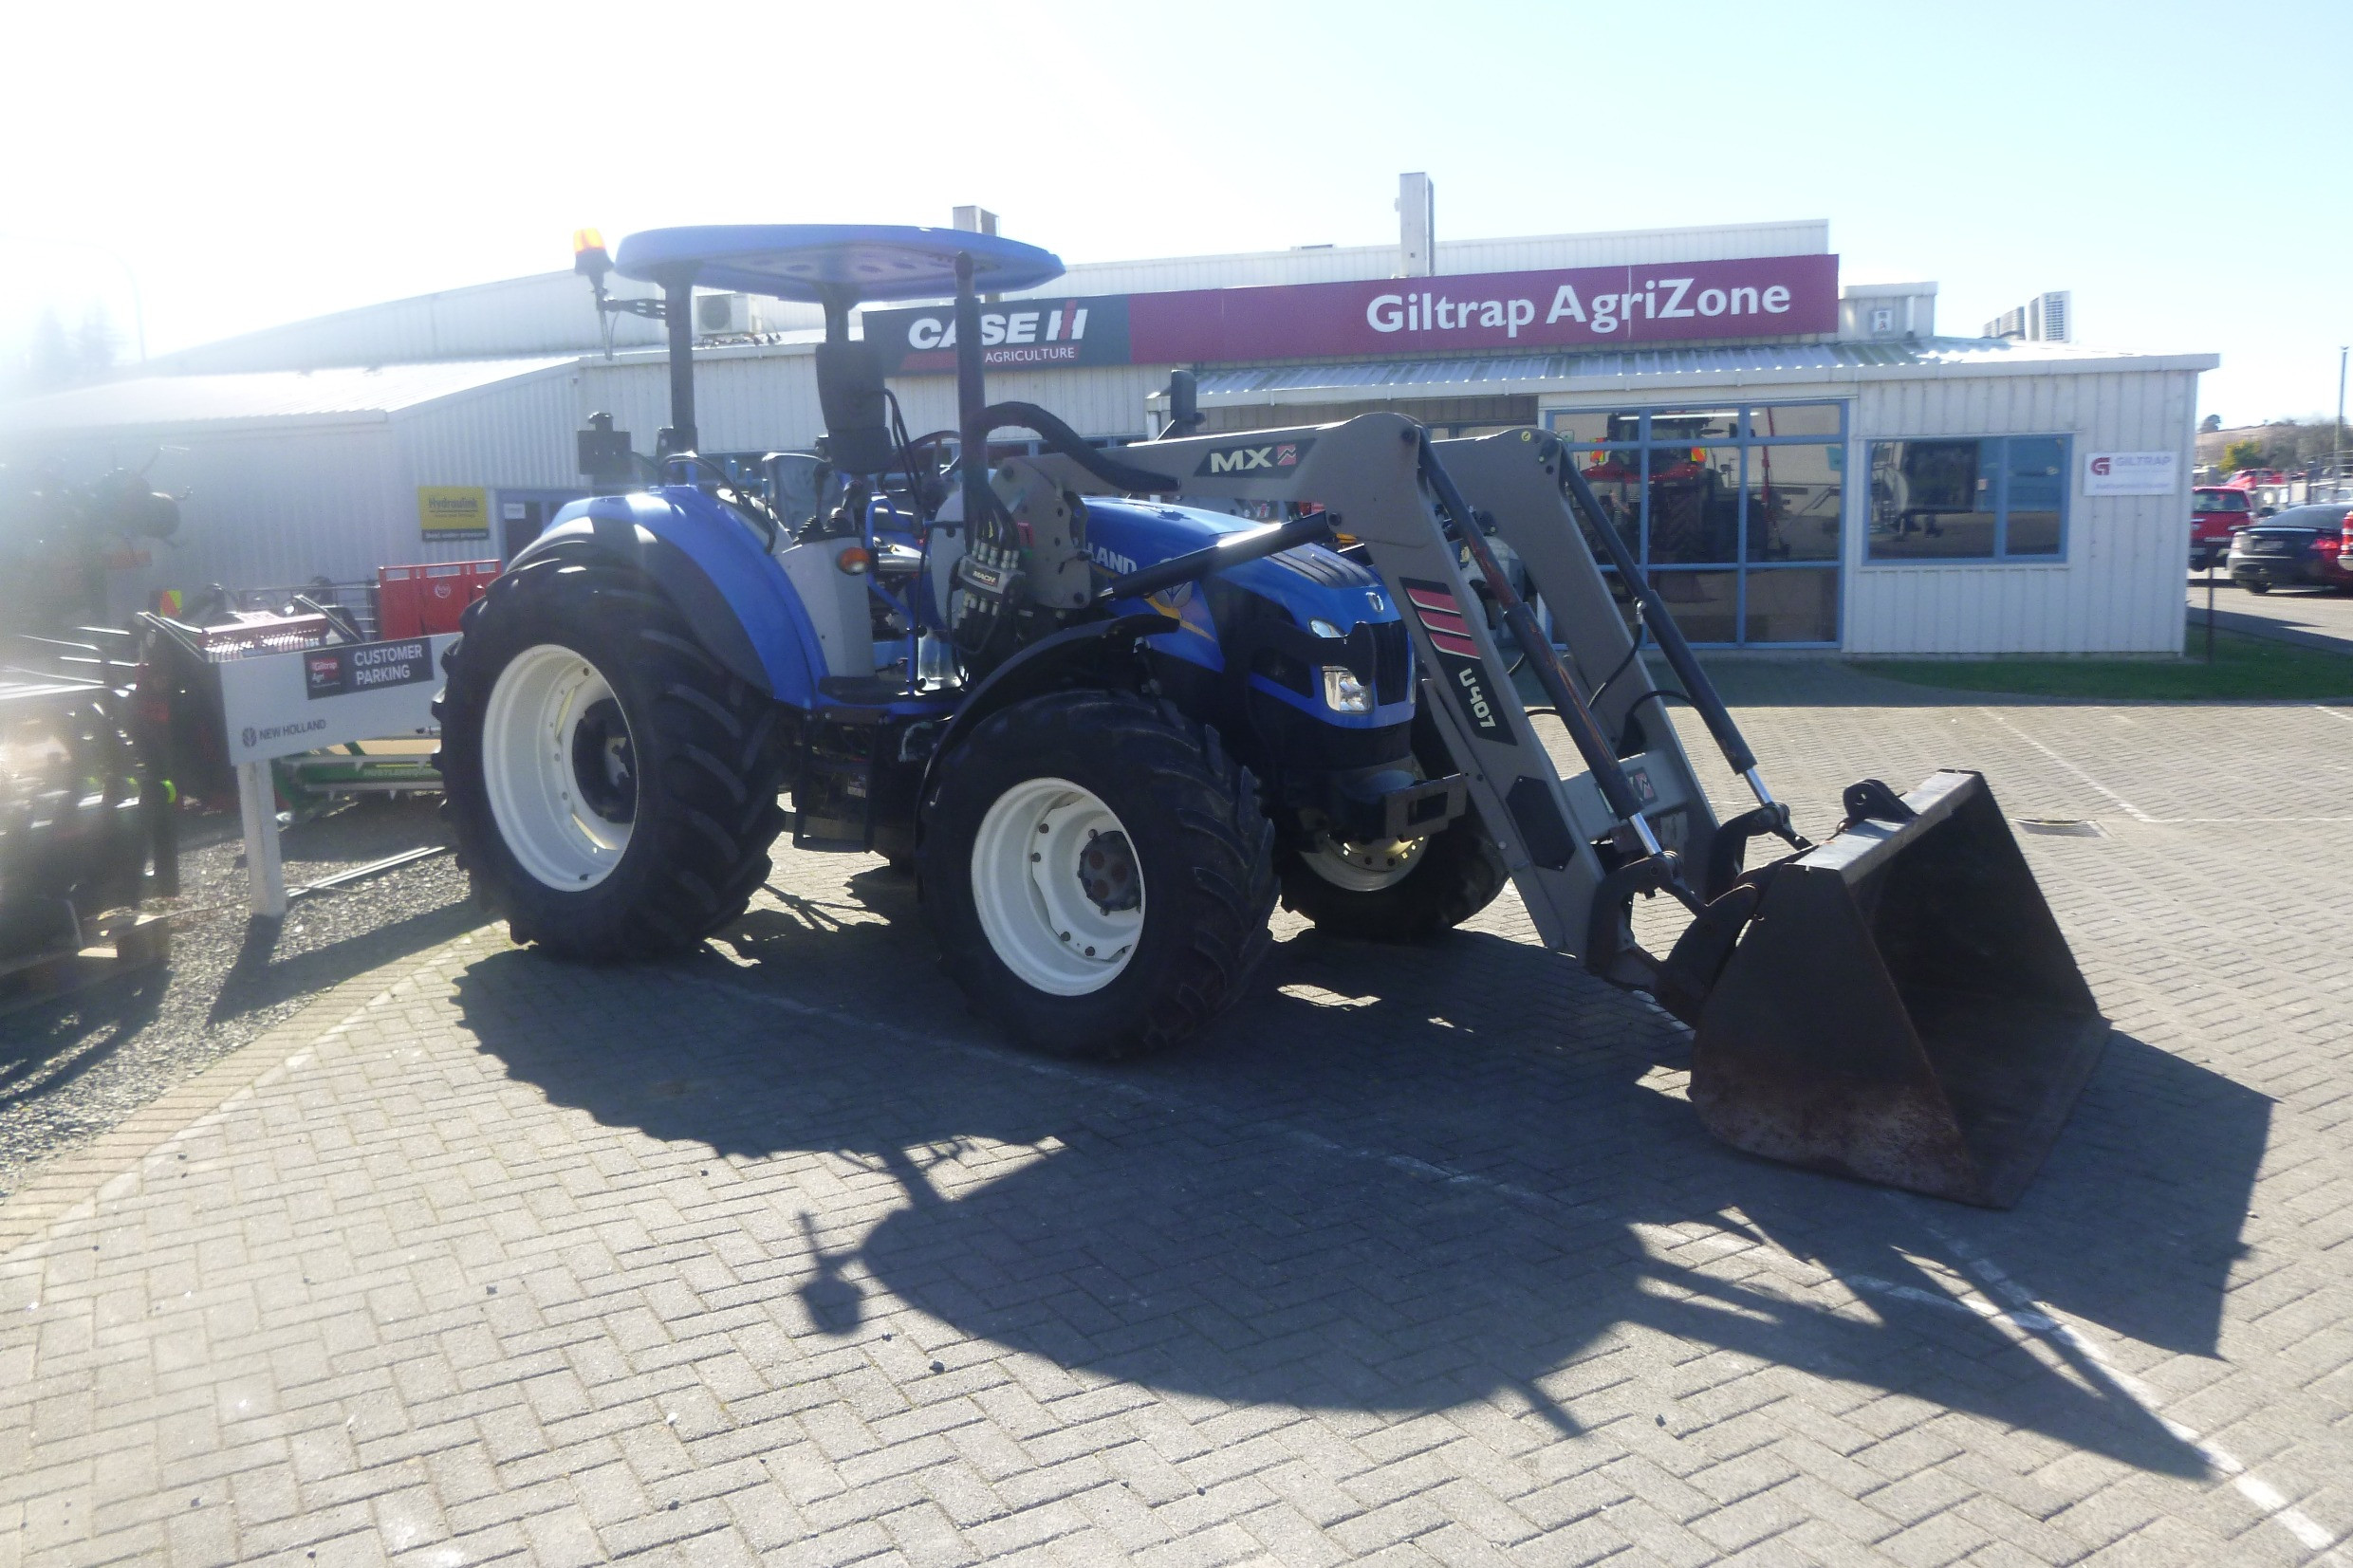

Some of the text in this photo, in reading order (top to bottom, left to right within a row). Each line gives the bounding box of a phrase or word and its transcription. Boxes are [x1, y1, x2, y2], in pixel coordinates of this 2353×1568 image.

[1366, 278, 1790, 338] Giltrap AgriZone
[985, 347, 1076, 363] AGRICULTURE
[1211, 447, 1272, 473] MX
[354, 644, 423, 667] CUSTOMER
[356, 664, 411, 686] PARKING
[259, 719, 326, 740] NEW HOLLAND
